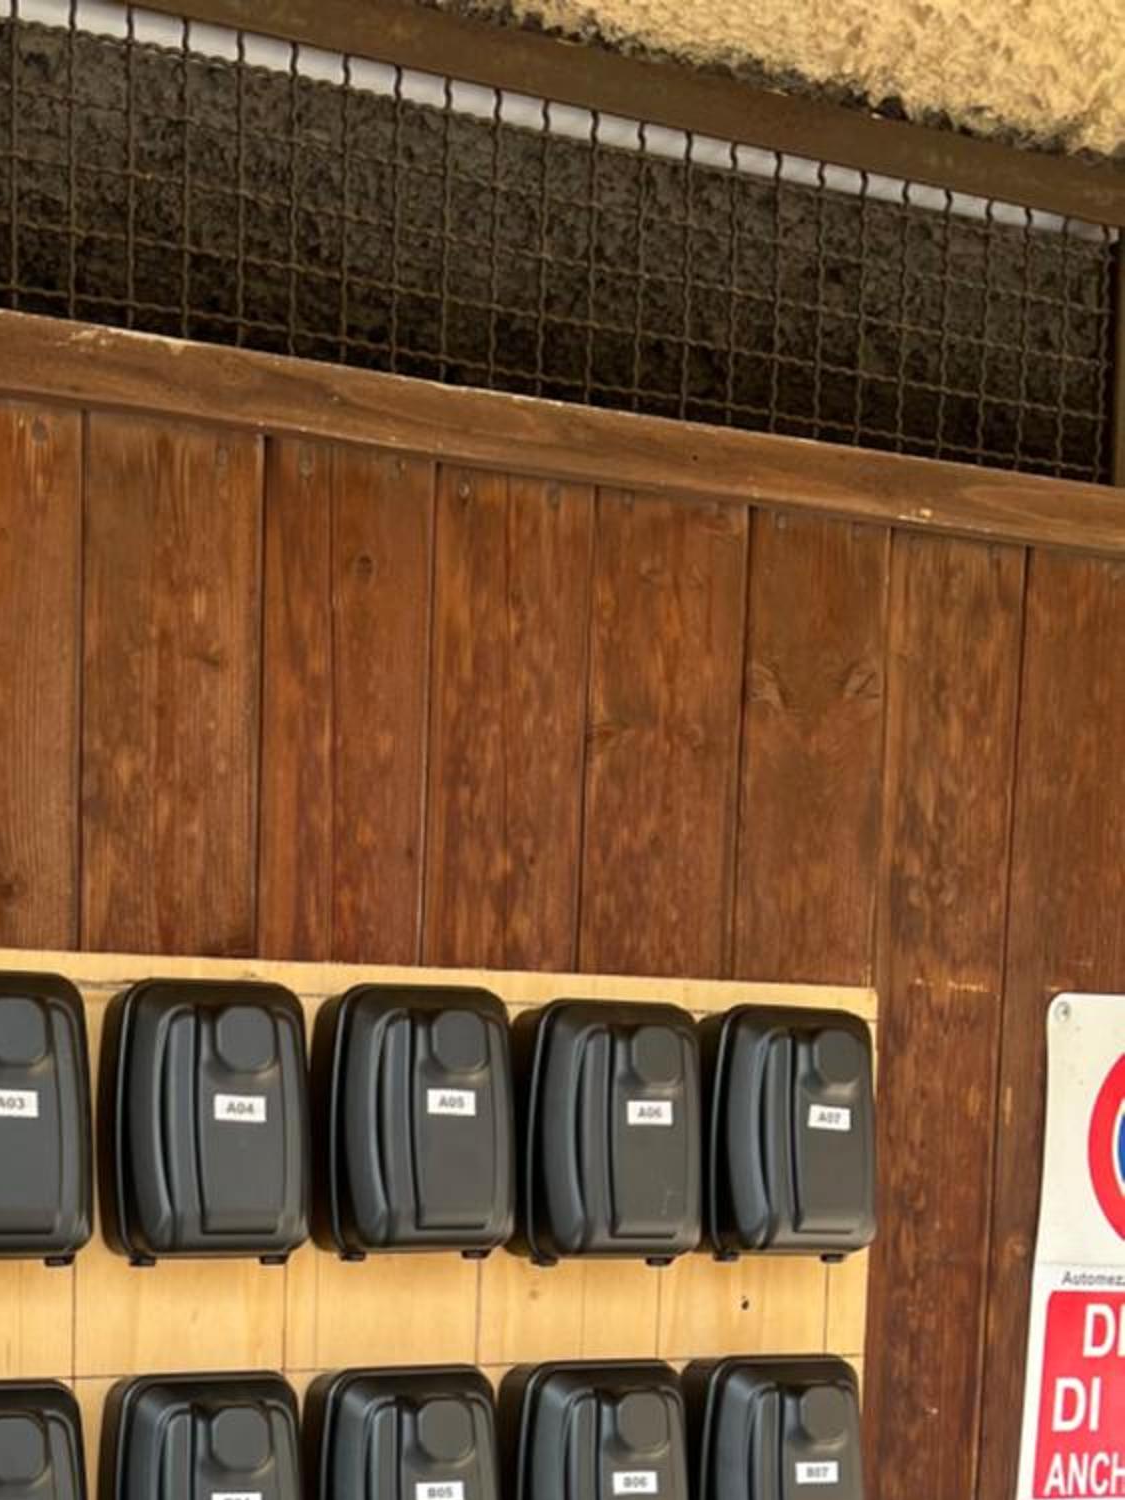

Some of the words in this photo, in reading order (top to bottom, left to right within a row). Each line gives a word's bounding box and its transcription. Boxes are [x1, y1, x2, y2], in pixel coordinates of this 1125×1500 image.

[226, 1102, 254, 1114] A04
[438, 1096, 464, 1109] A05
[637, 1106, 662, 1118] A06
[1053, 1377, 1100, 1432] DI
[623, 1477, 646, 1488] B06
[427, 1487, 453, 1499] B05
